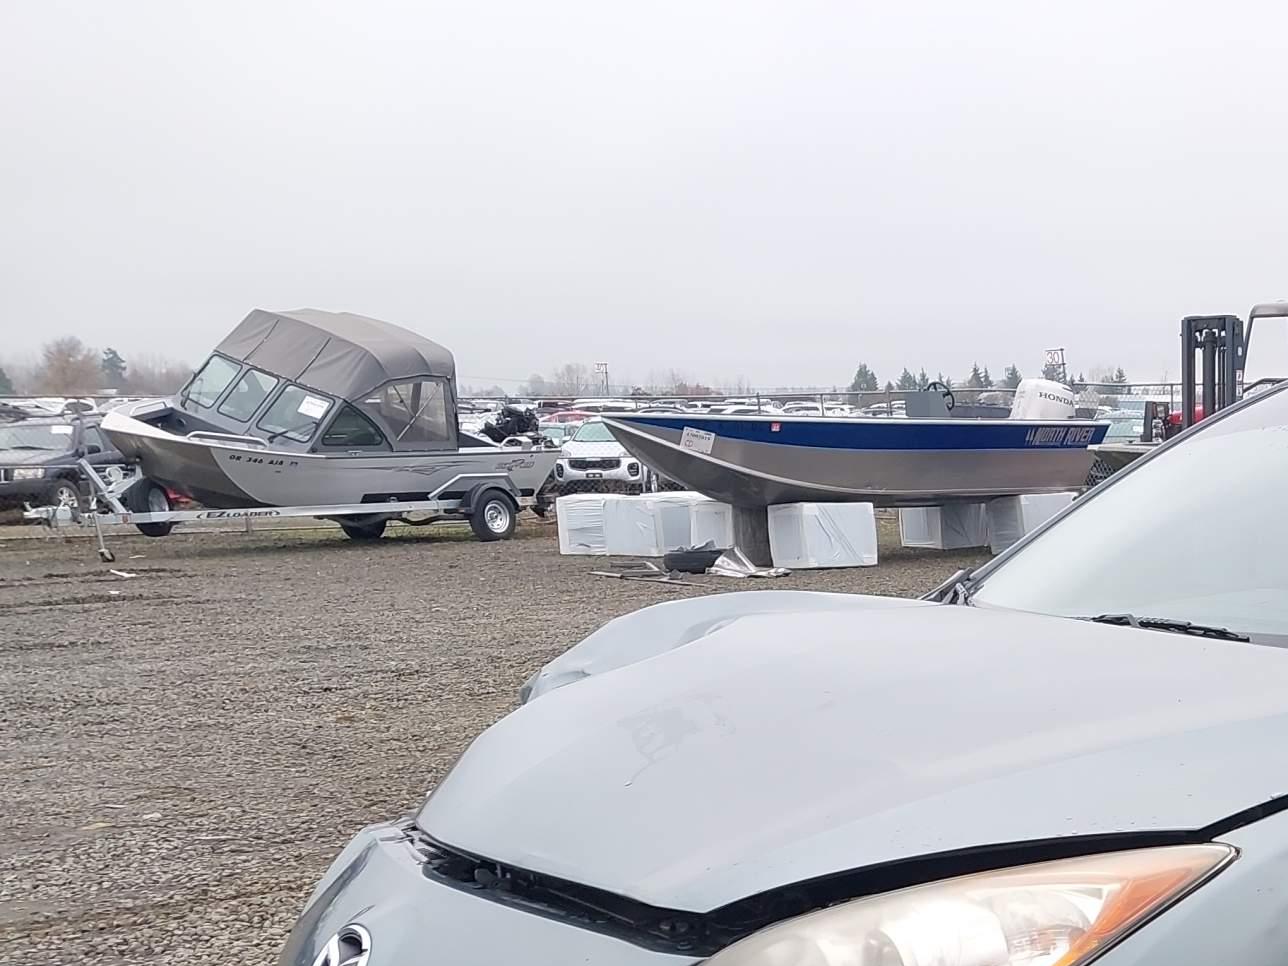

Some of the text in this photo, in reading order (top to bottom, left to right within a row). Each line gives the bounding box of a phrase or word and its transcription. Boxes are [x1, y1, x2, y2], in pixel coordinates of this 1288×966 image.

[1046, 351, 1060, 364] 30
[1039, 391, 1074, 407] HONDA
[1063, 427, 1096, 445] RIVER
